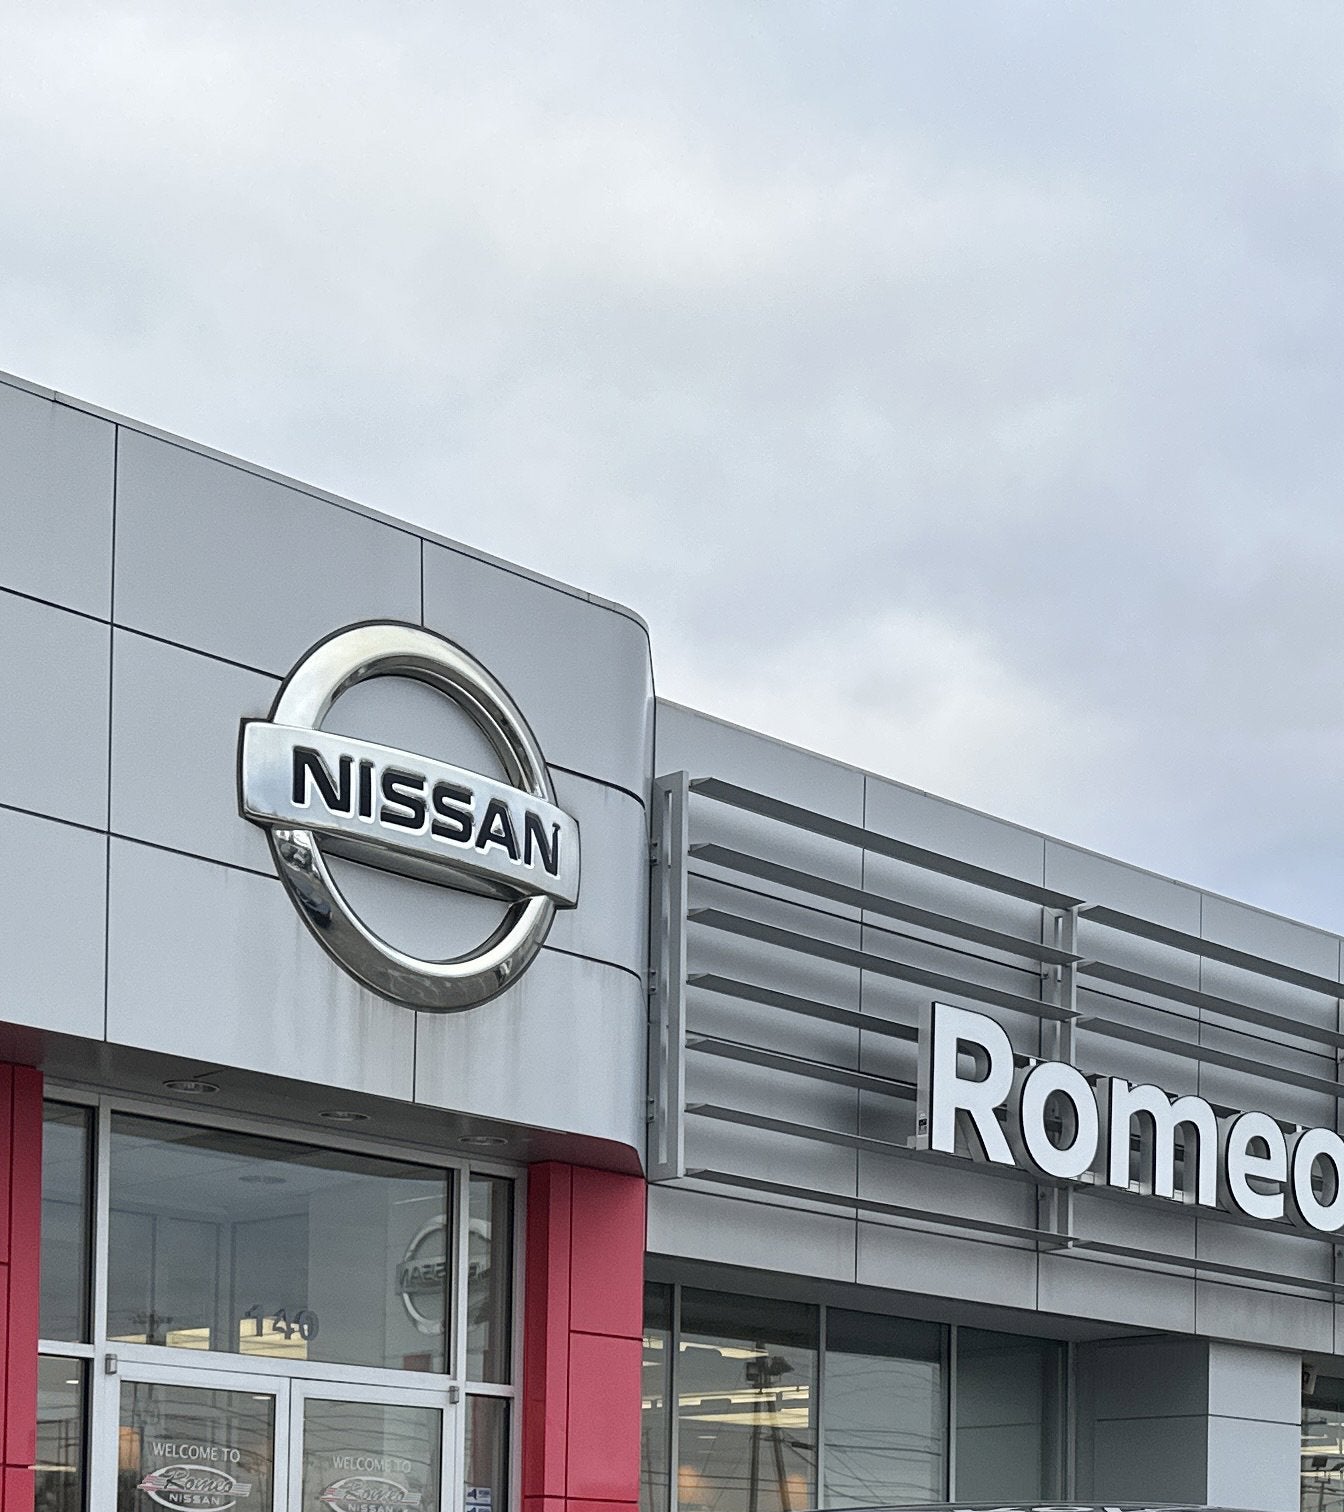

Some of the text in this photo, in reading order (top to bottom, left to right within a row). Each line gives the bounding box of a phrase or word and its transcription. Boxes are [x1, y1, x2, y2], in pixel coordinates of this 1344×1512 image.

[291, 746, 562, 879] NISSAN
[245, 1303, 319, 1342] 140
[153, 1442, 240, 1462] WELCOME TO
[333, 1456, 412, 1473] WELCOME TO
[169, 1493, 220, 1505] NISSAN
